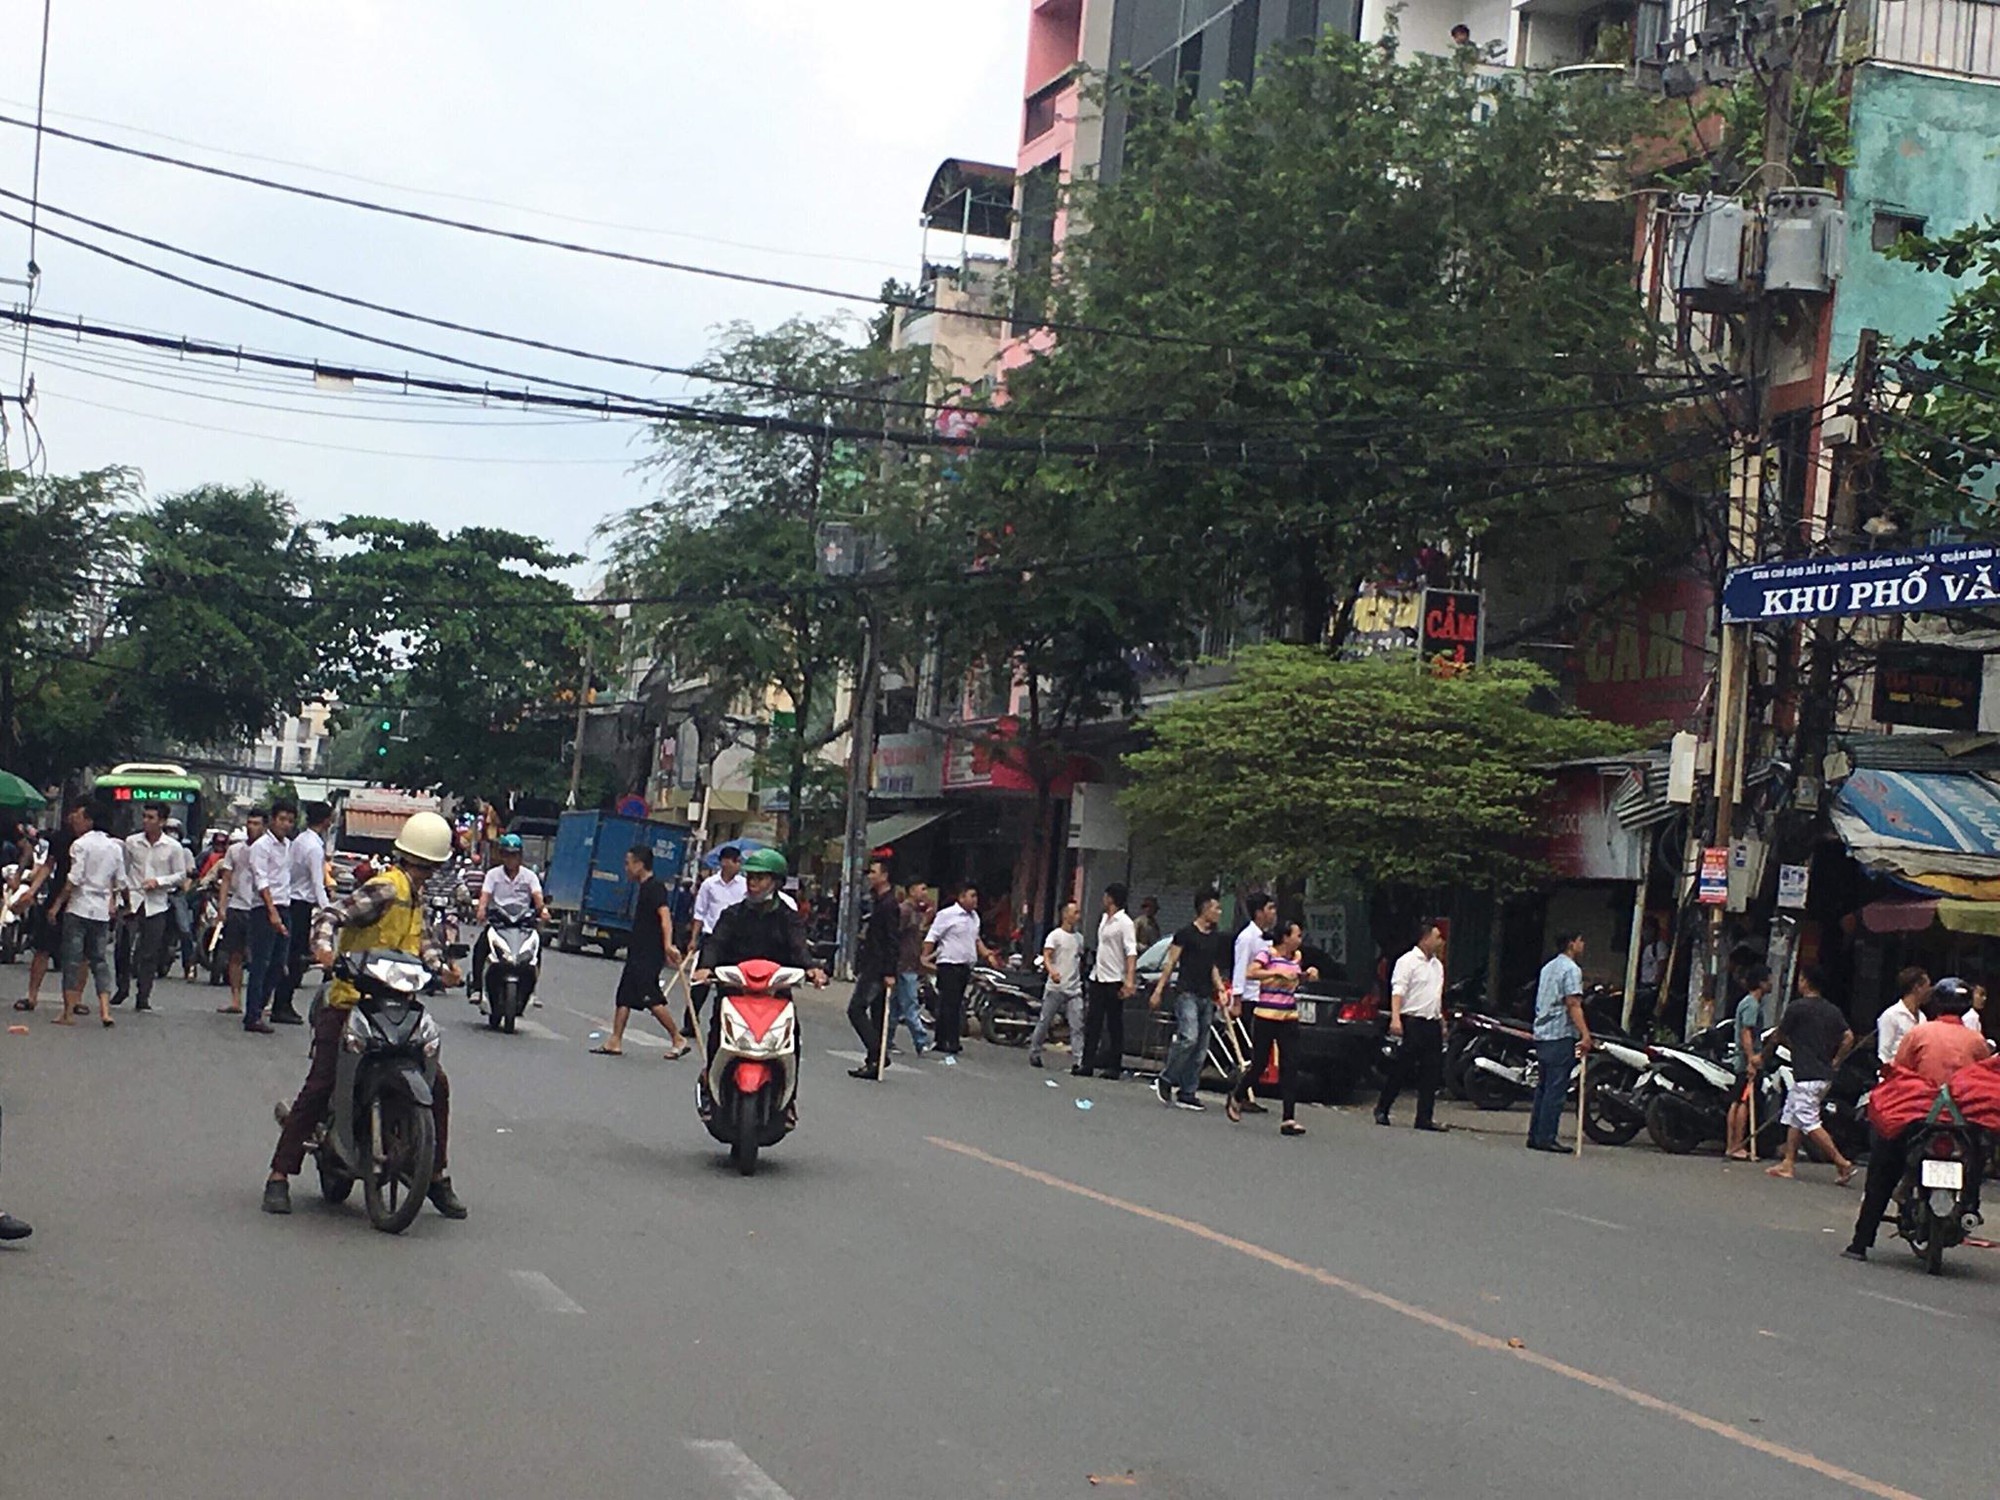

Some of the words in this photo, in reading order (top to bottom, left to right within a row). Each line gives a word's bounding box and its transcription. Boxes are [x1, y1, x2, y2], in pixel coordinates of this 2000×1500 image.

[1760, 583, 1841, 616] KHU
[1847, 565, 1930, 610] PHỐ
[1940, 564, 2000, 603] VĂ
